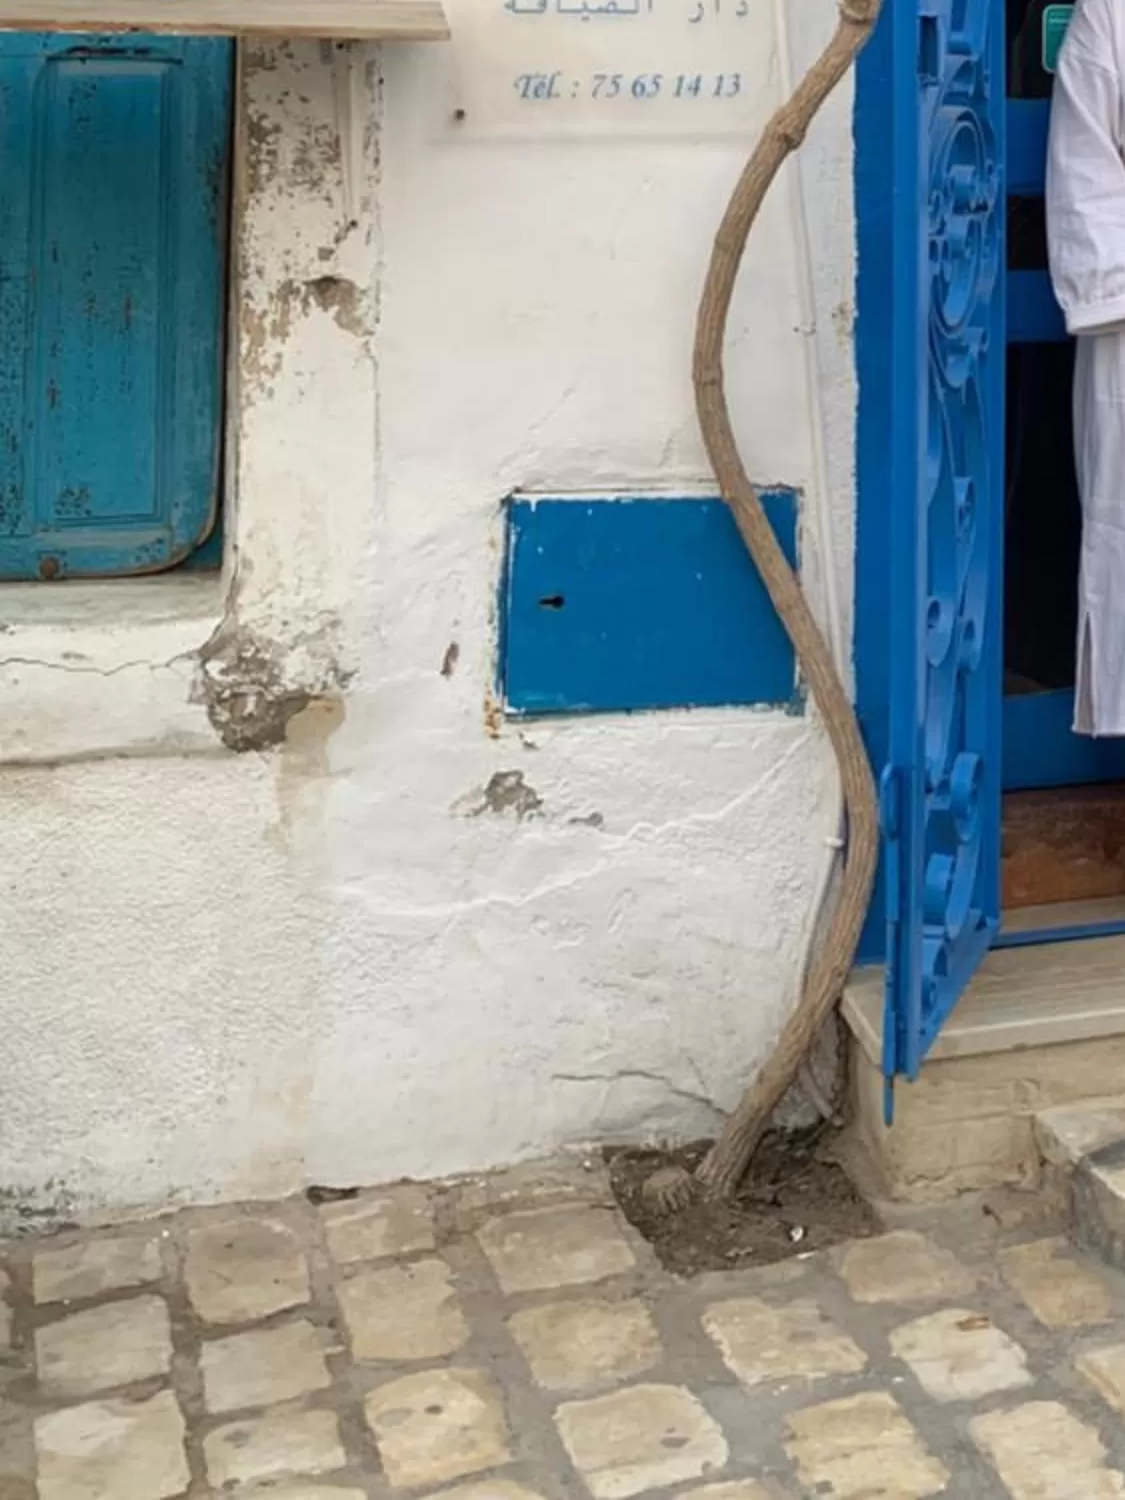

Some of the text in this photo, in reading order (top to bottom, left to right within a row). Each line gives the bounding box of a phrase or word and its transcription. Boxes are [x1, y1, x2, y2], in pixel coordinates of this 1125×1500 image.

[591, 72, 623, 99] 75
[631, 72, 664, 99] 65
[672, 73, 703, 99] 14
[712, 72, 742, 98] 13
